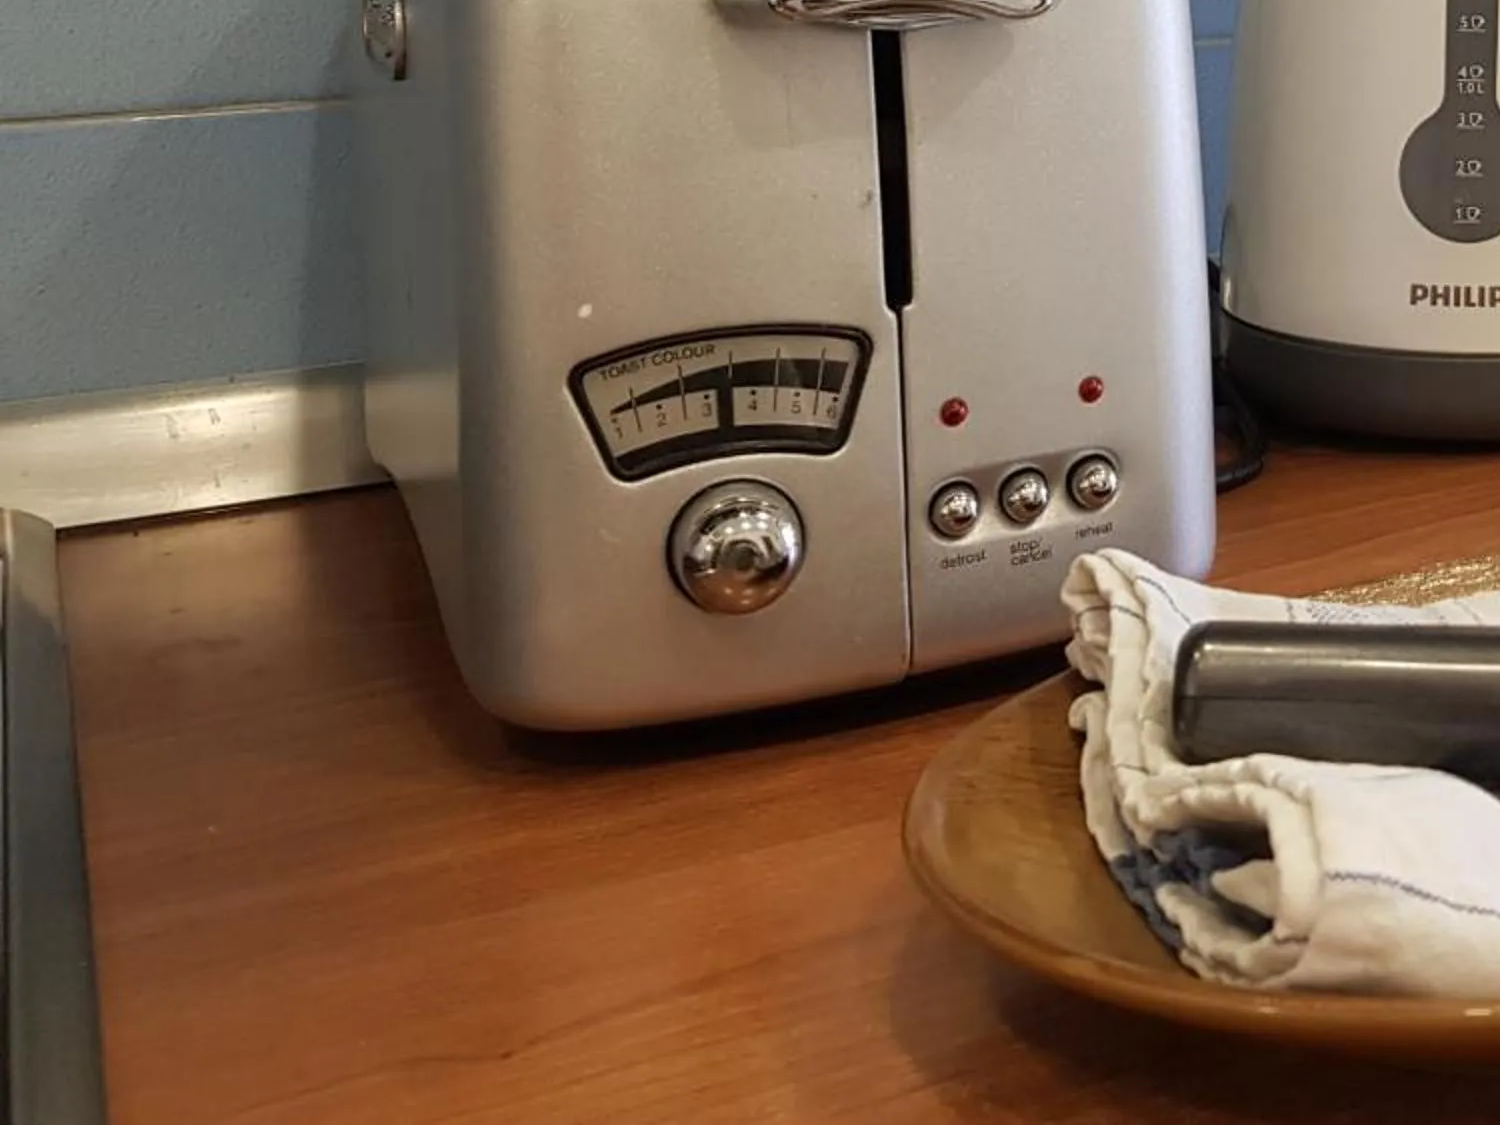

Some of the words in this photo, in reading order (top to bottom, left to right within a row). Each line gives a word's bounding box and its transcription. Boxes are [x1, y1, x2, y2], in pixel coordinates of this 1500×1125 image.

[651, 344, 716, 367] COLOUR
[941, 549, 987, 570] defrost
[1010, 548, 1053, 567] cancel
